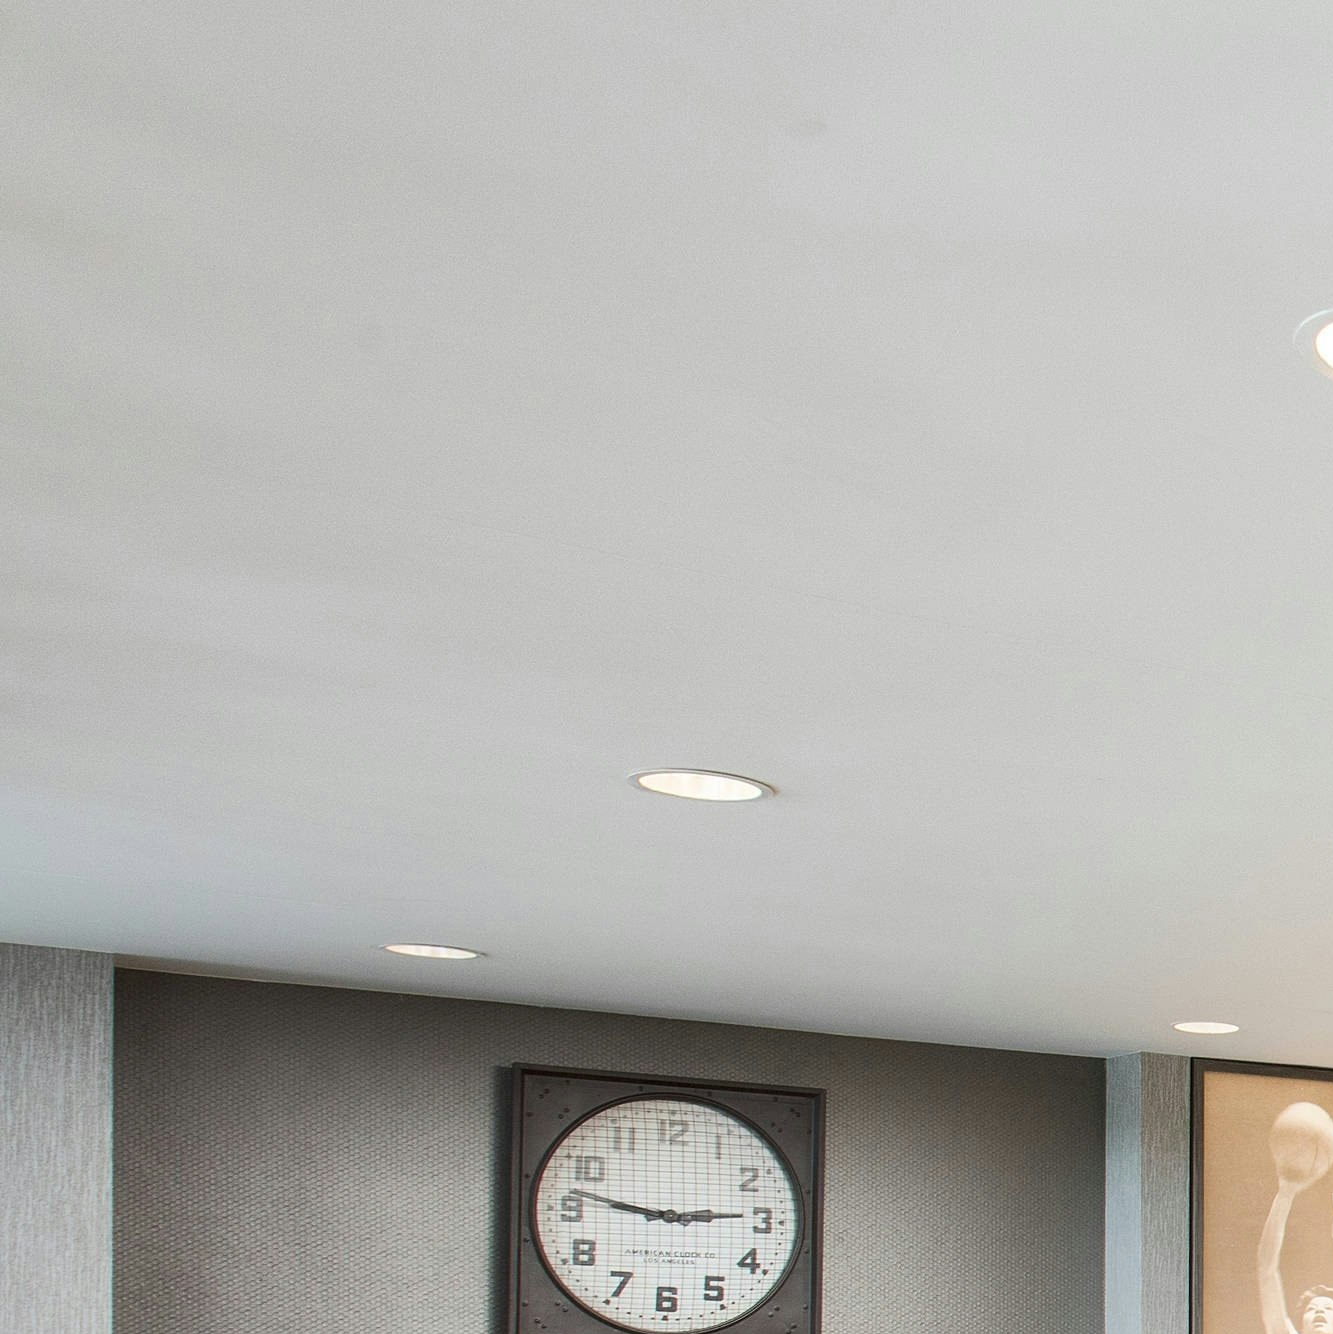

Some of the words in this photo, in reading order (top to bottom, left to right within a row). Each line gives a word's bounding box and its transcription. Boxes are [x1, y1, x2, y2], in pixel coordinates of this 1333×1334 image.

[613, 1126, 635, 1153] 11
[659, 1119, 690, 1145] 12
[575, 1155, 605, 1182] 10
[739, 1167, 759, 1192] 2
[561, 1195, 583, 1222] 9
[753, 1207, 772, 1234] 3
[573, 1239, 596, 1266] 8
[625, 1249, 671, 1257] AMERICAN
[737, 1248, 760, 1274] 4
[610, 1270, 634, 1297] 7
[704, 1275, 725, 1302] 5
[656, 1286, 678, 1313] 6
